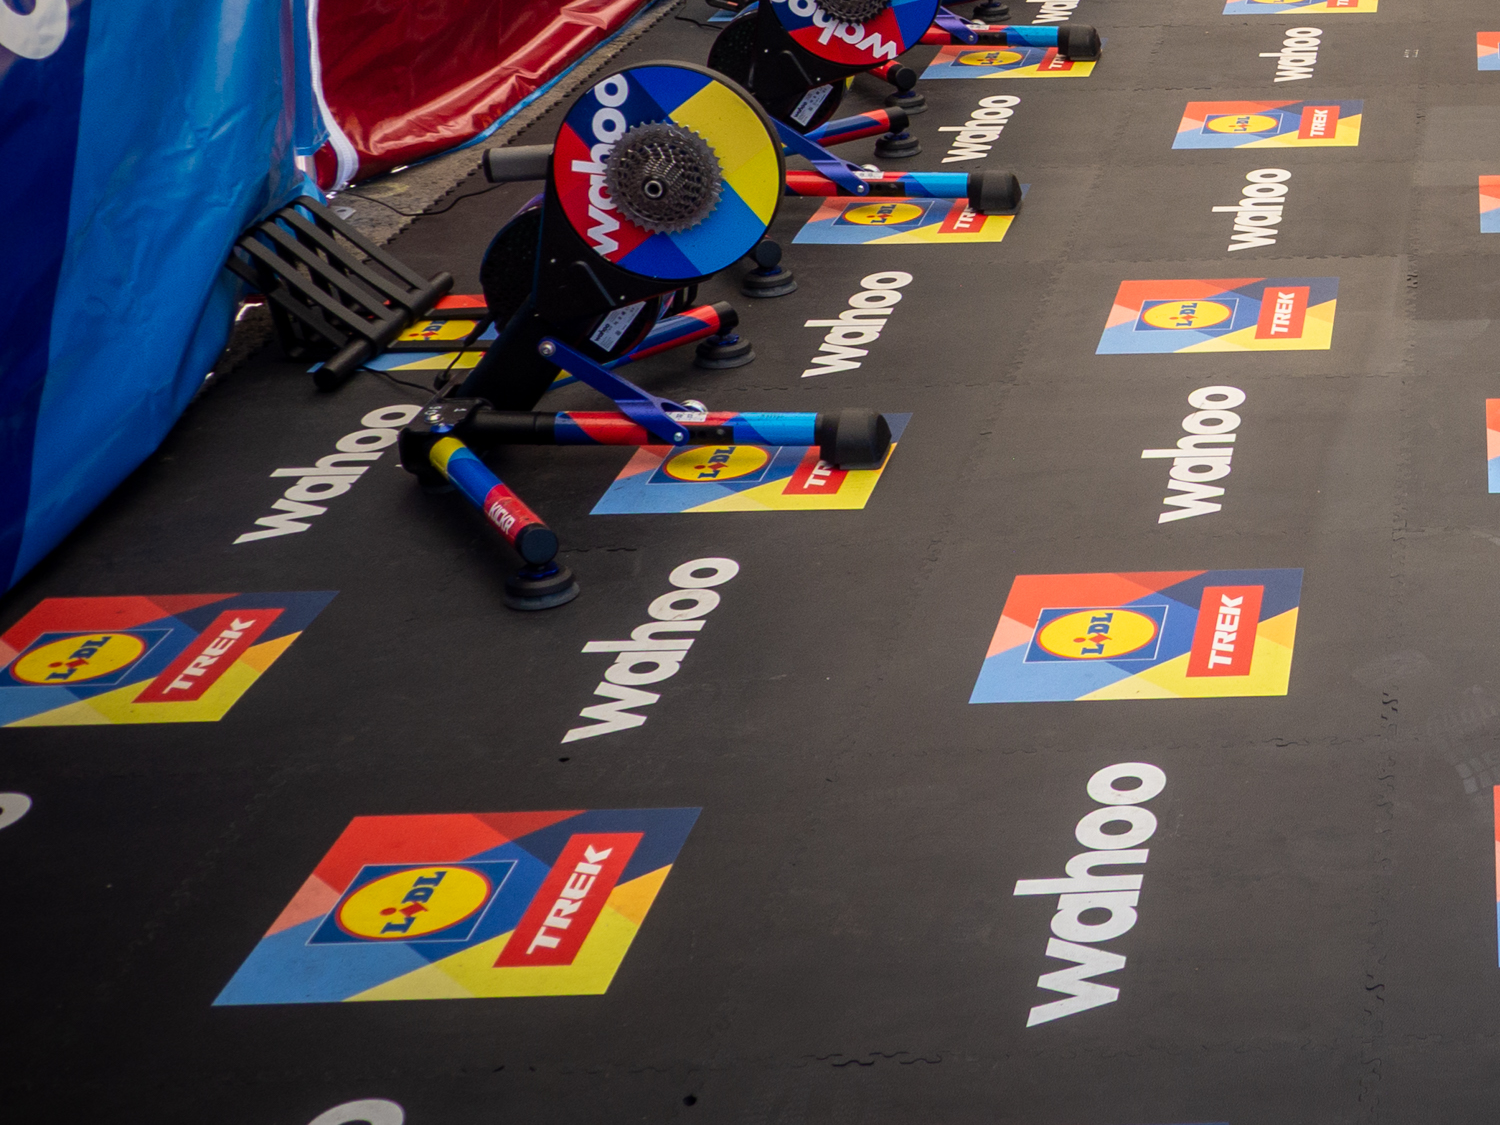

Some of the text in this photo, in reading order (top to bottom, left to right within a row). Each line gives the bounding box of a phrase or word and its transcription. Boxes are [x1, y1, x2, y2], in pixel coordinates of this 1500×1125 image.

[1258, 26, 1323, 83] wahoo
[938, 94, 1021, 164] wahoo
[1309, 108, 1329, 138] TREK
[571, 73, 630, 263] wahoo
[1211, 168, 1292, 252] wahoo
[801, 271, 914, 378] wahoo
[1270, 291, 1296, 336] TREK
[232, 404, 424, 545] wahoo
[1140, 385, 1247, 525] wahoo
[488, 501, 516, 535] KICKR
[161, 616, 258, 696] TREK
[560, 557, 740, 744] wahoo
[1207, 593, 1245, 670] TREK
[526, 843, 614, 956] TREK
[1012, 761, 1168, 1028] wahoo
